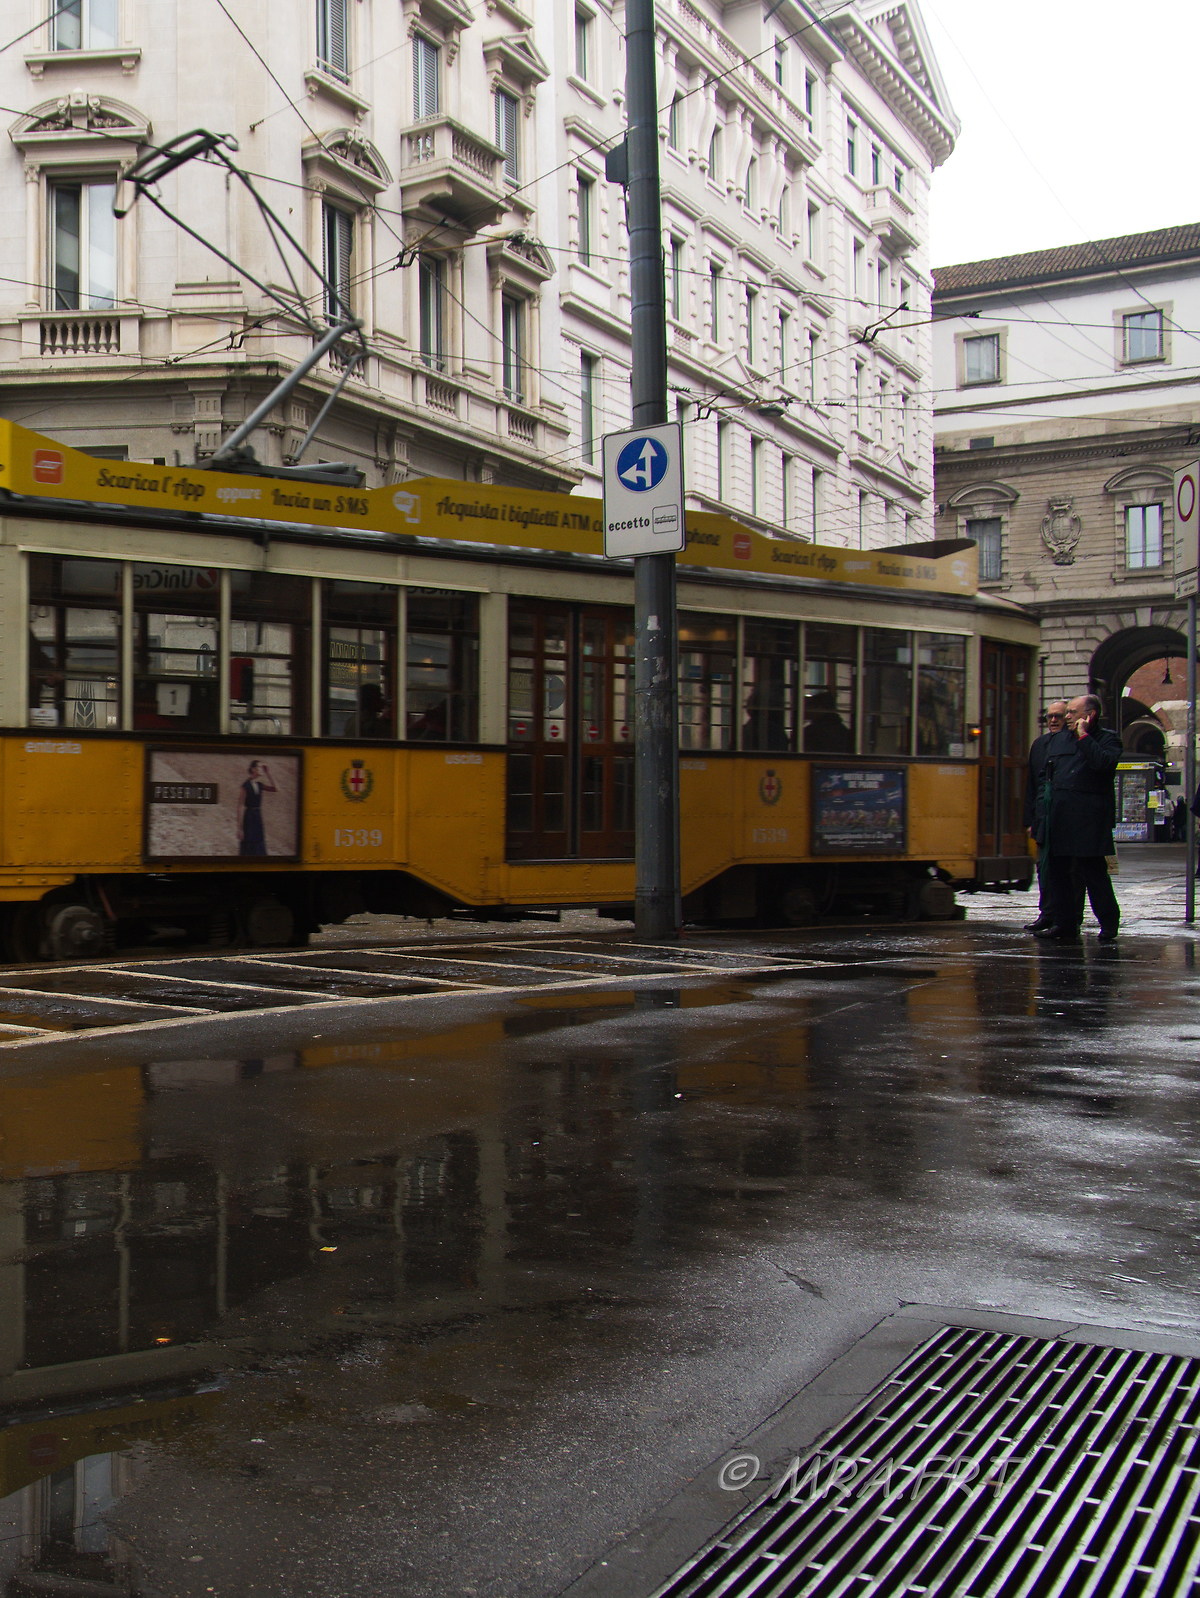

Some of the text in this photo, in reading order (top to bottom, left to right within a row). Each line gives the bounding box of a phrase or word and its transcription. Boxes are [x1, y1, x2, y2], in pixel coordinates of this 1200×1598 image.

[97, 468, 160, 493] Scarica
[334, 496, 369, 515] SMS
[436, 496, 499, 521] Acquista
[509, 505, 559, 529] biglietti
[561, 513, 590, 531] ATM
[608, 517, 650, 531] eccetto
[24, 740, 82, 754] entrata
[154, 786, 212, 800] PESERICO
[334, 828, 383, 848] 1539
